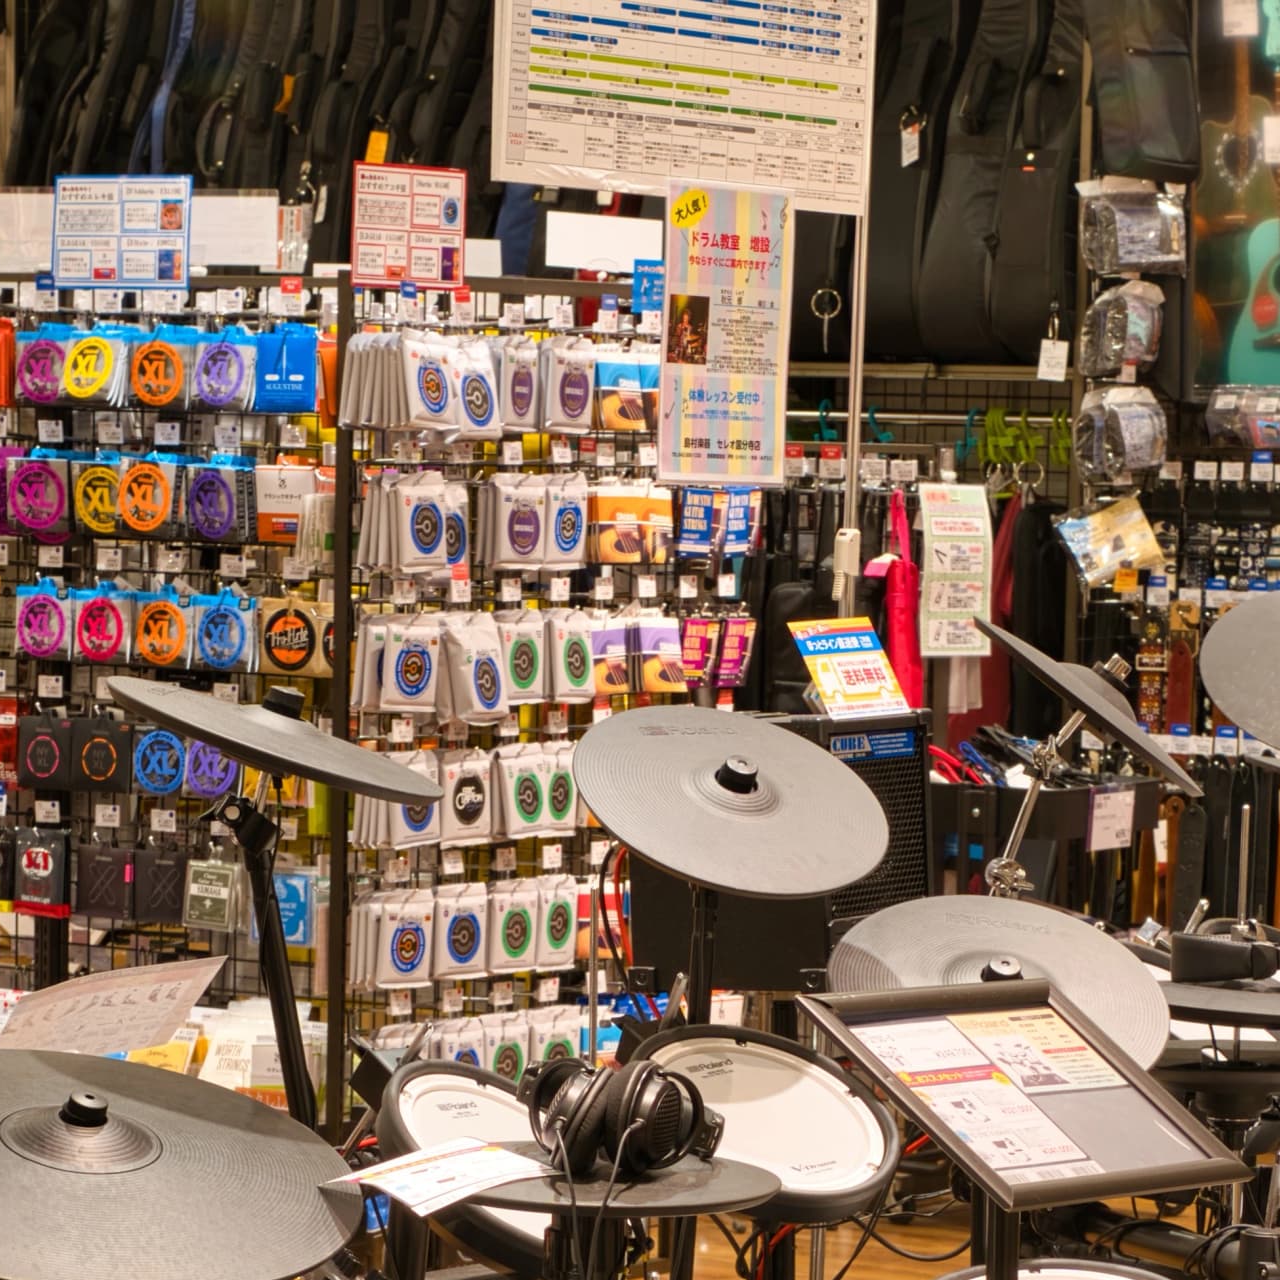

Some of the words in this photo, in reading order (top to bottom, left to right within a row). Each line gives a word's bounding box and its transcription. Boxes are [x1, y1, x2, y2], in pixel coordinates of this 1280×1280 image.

[692, 231, 740, 251] ドラム教室
[31, 357, 58, 384] XL
[71, 353, 100, 380] XL
[141, 359, 173, 387] XL
[207, 358, 237, 384] XL
[265, 382, 304, 391] AUGUSTINE
[688, 389, 760, 406] 体験レッスン受付中
[20, 481, 54, 510] XL
[86, 485, 117, 512] XL
[131, 481, 163, 509] XL
[28, 613, 54, 640] XL
[87, 616, 113, 641] XL
[147, 616, 179, 644] XL
[210, 621, 235, 648] XL
[832, 735, 866, 751] CUBE
[144, 756, 177, 784] XL
[194, 755, 226, 781] XL
[215, 1044, 243, 1057] WORTH
[216, 1057, 250, 1072] STRINGS
[697, 1058, 734, 1072] Roland
[448, 1101, 477, 1111] Roland
